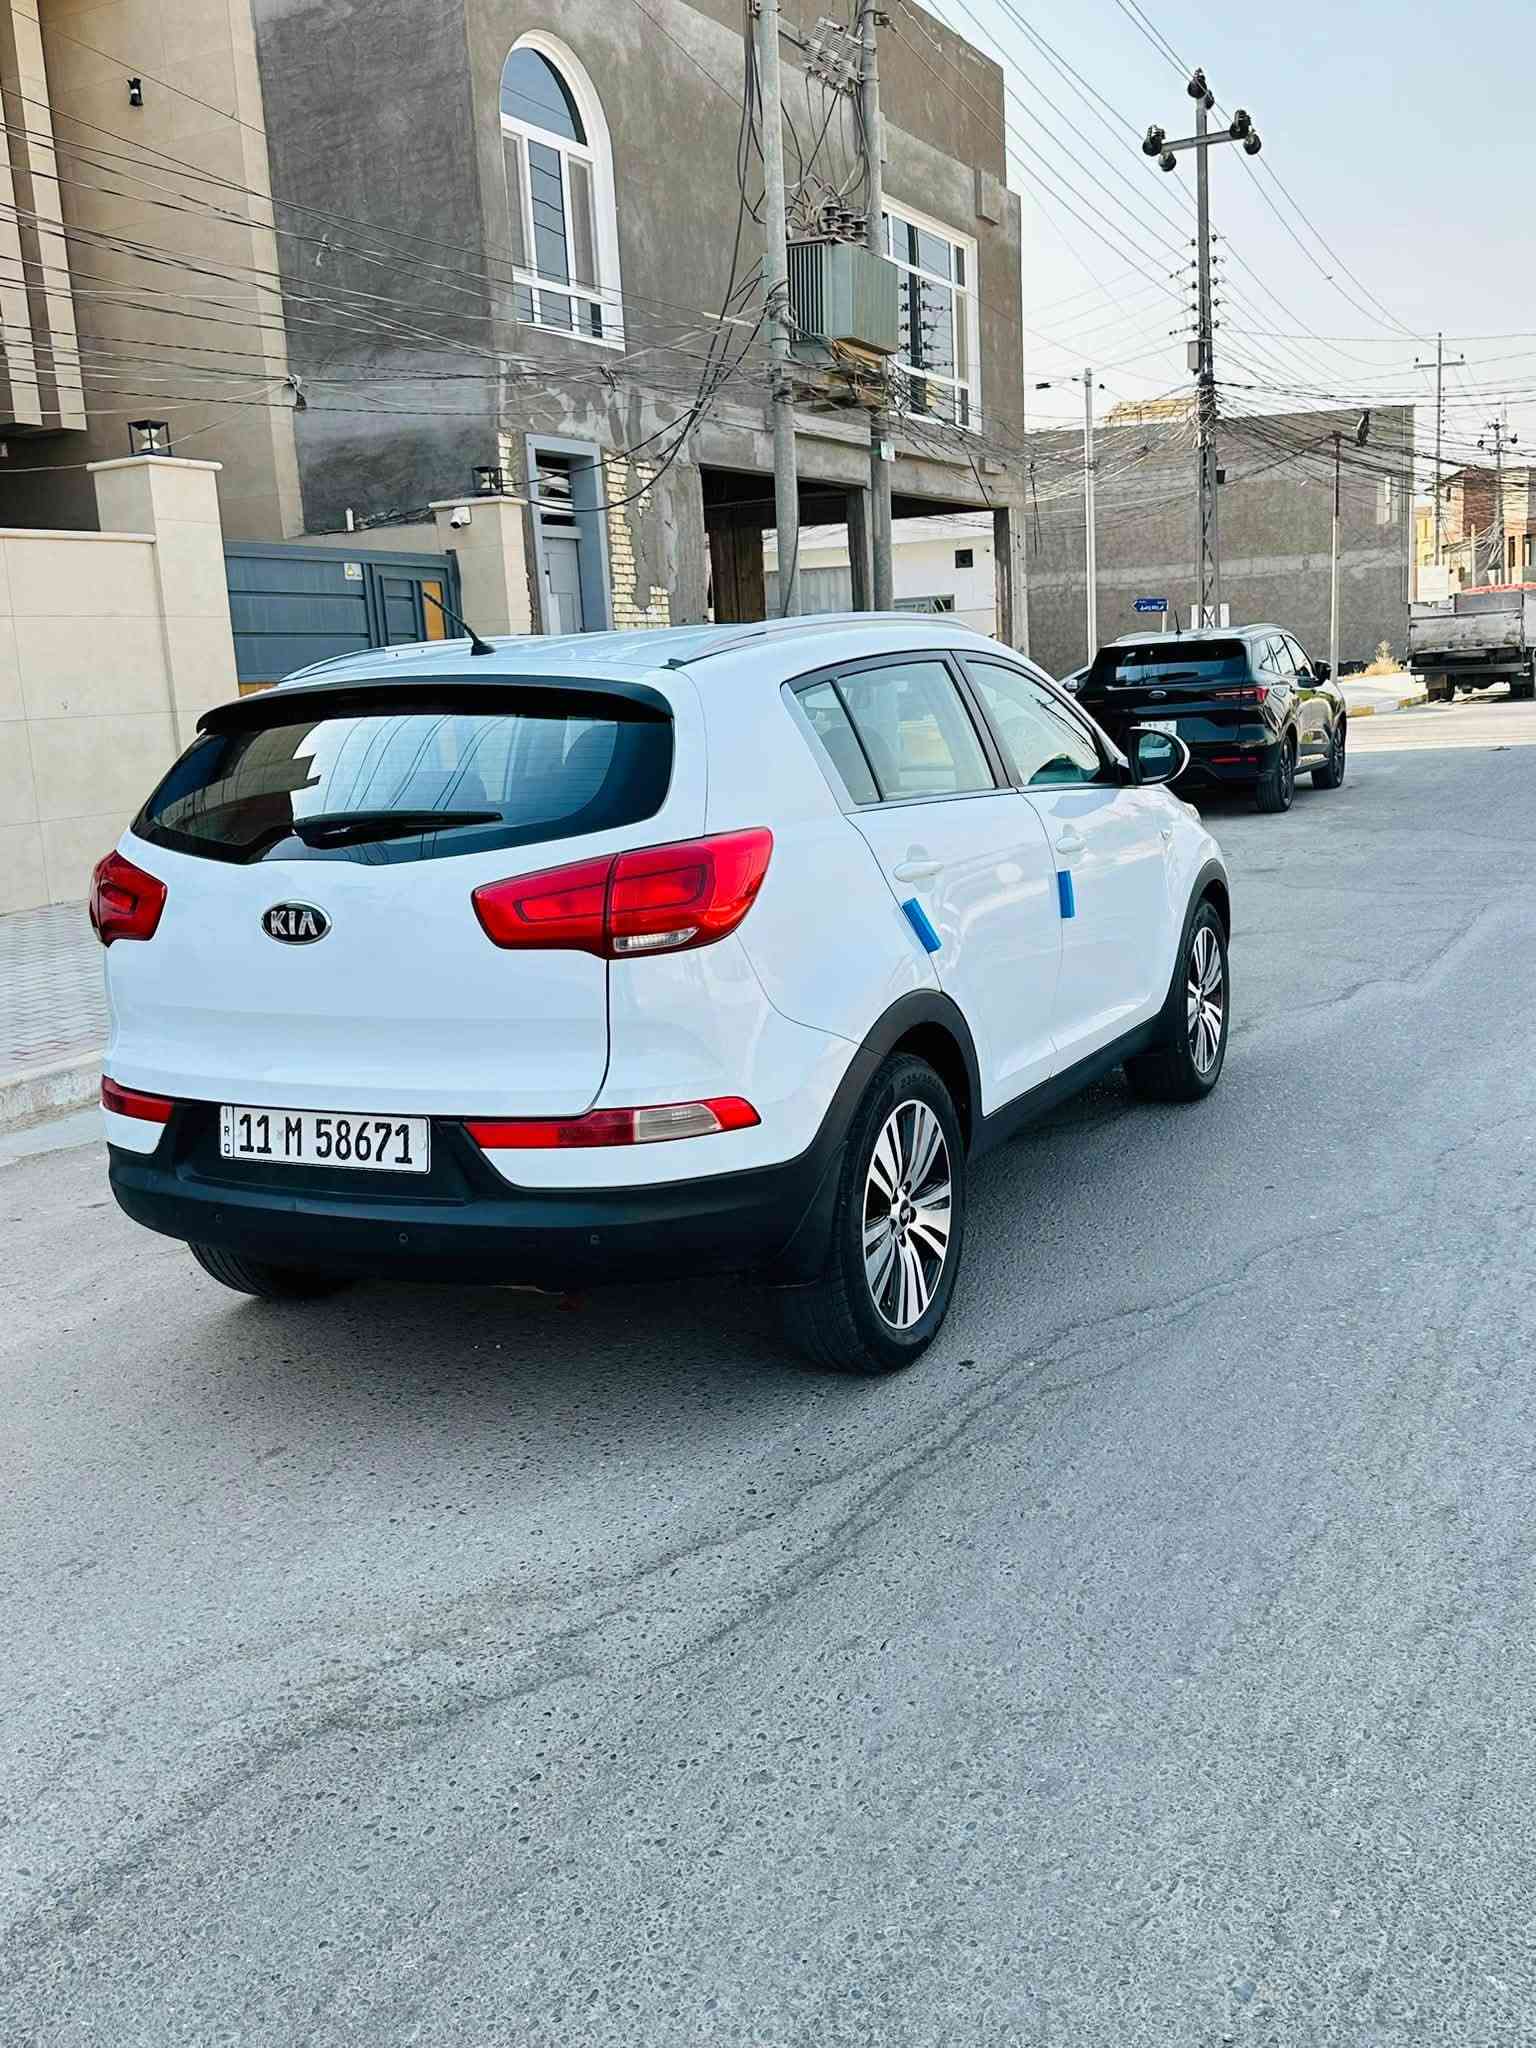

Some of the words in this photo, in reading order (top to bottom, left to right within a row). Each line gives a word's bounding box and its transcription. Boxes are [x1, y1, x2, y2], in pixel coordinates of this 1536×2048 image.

[270, 910, 318, 935] KIA
[239, 1113, 273, 1154] 11
[285, 1116, 302, 1157] M
[315, 1118, 413, 1164] 58671
